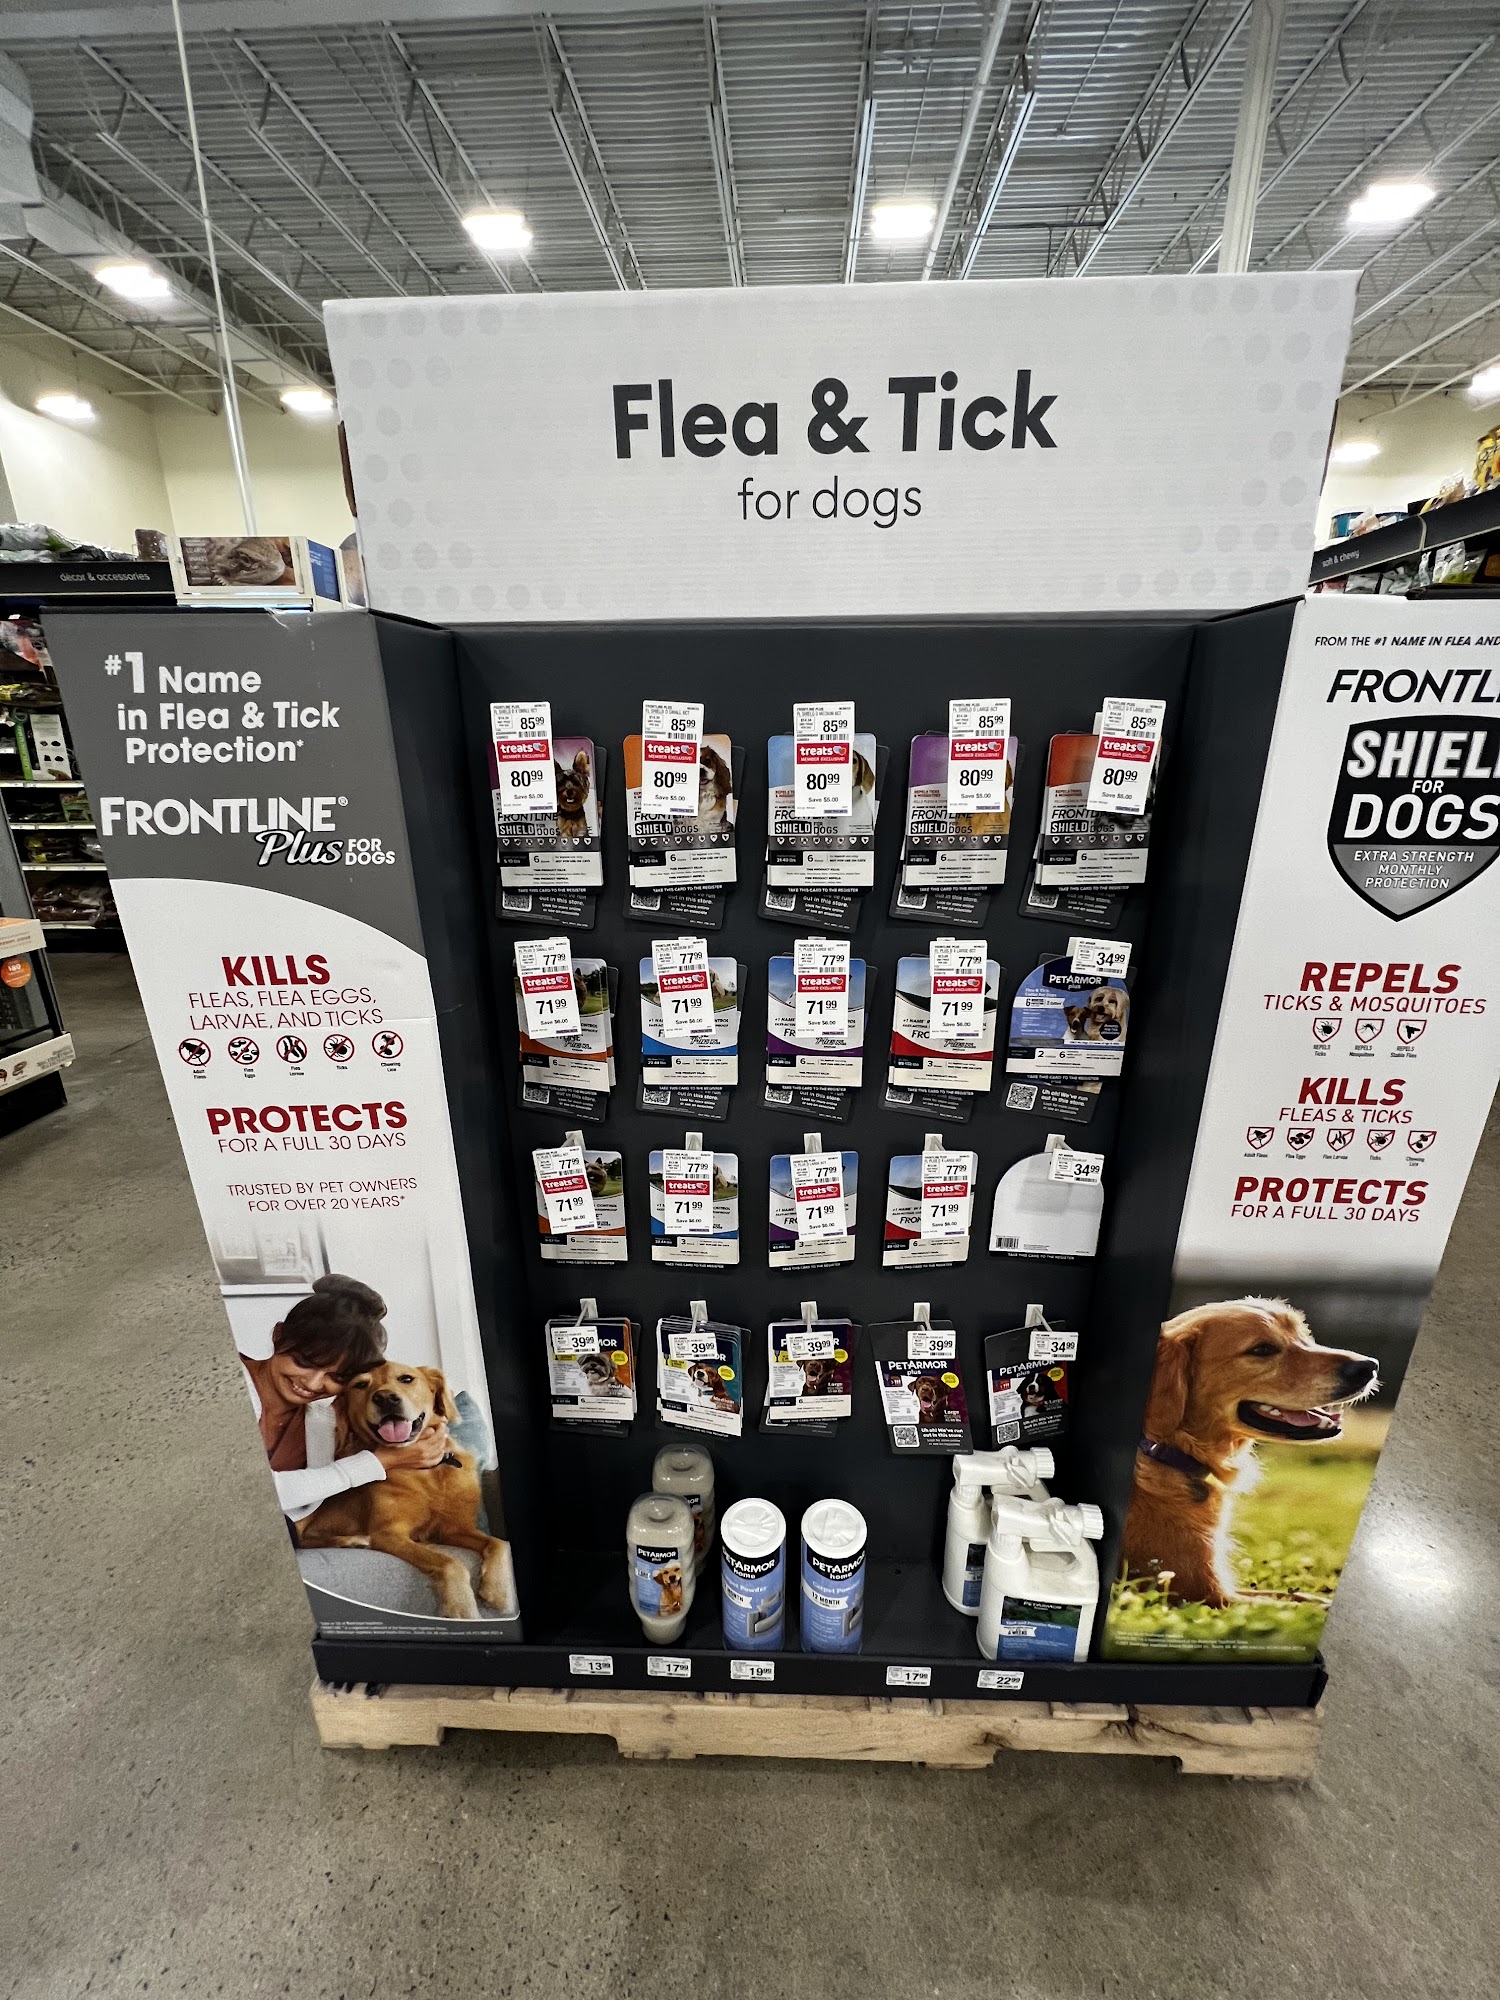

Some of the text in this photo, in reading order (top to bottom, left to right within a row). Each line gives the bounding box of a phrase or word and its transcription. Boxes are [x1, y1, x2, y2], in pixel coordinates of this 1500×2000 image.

[612, 369, 1059, 459] Flea & Tick
[737, 475, 922, 529] for dogs
[1339, 550, 1358, 561] chewy
[1314, 636, 1500, 647] FROM THE #1 NAME IN FLEA AND
[104, 651, 262, 694] #1 Name
[1326, 668, 1500, 703] FRONTL
[117, 700, 341, 731] in Flea & Tick
[500, 743, 534, 754] treats
[647, 743, 681, 755] treats
[799, 745, 833, 756] treats
[954, 741, 988, 752] treats
[1103, 740, 1137, 752] treats
[1346, 730, 1500, 779] SHIEL
[1411, 780, 1445, 794] FOR
[1343, 793, 1500, 840] DOGS
[500, 824, 535, 836] SHIELD
[635, 823, 699, 836] SHIELD DOGS
[775, 822, 839, 835] SHIELD DOGS
[911, 822, 973, 834] SHIELD DOGS
[1051, 821, 1088, 833] SHIELD
[254, 829, 382, 867] Plus FOR
[344, 850, 396, 866] DOGS
[1354, 850, 1475, 863] EXTRA STRENGTH
[1378, 864, 1444, 876] MONTHLY
[1365, 877, 1450, 889] PROTECTION
[221, 954, 331, 987] KILLS
[525, 977, 557, 987] treats
[661, 975, 693, 986] treats
[800, 976, 831, 986] treats
[936, 978, 968, 987] treats
[1048, 974, 1102, 985] PETARMOR
[1299, 961, 1462, 995] REPELS
[188, 987, 377, 1009] FLEAS, FLEA EGGS,
[1263, 994, 1487, 1014] TICKS & MOSQUITOES
[190, 1008, 384, 1031] LARVAE, AND TICKS
[1297, 1077, 1406, 1106] KILLS
[206, 1101, 408, 1136] PROTECTS
[1279, 1107, 1413, 1124] FLEAS & TICKS
[218, 1132, 406, 1153] FOR A FULL 30 DAYS
[226, 1177, 418, 1197] TRUSTED BY PET OWNERS
[544, 1179, 573, 1189] treats
[667, 1182, 697, 1190] treats
[925, 1185, 955, 1193] treats
[798, 1187, 827, 1197] treats
[1233, 1176, 1430, 1206] PROTECTS
[248, 1200, 280, 1212] FOR
[284, 1198, 327, 1211] OVER
[330, 1198, 349, 1210] 20
[1231, 1204, 1420, 1222] FOR A FULL 30 DAYS
[888, 1360, 948, 1371] PETARMOR
[999, 1360, 1056, 1377] PETARMOR
[1016, 1370, 1030, 1378] plus
[637, 1548, 677, 1559] PETARMOR
[733, 1567, 756, 1580] home
[830, 1571, 853, 1580] home
[819, 1596, 841, 1606] MONTH
